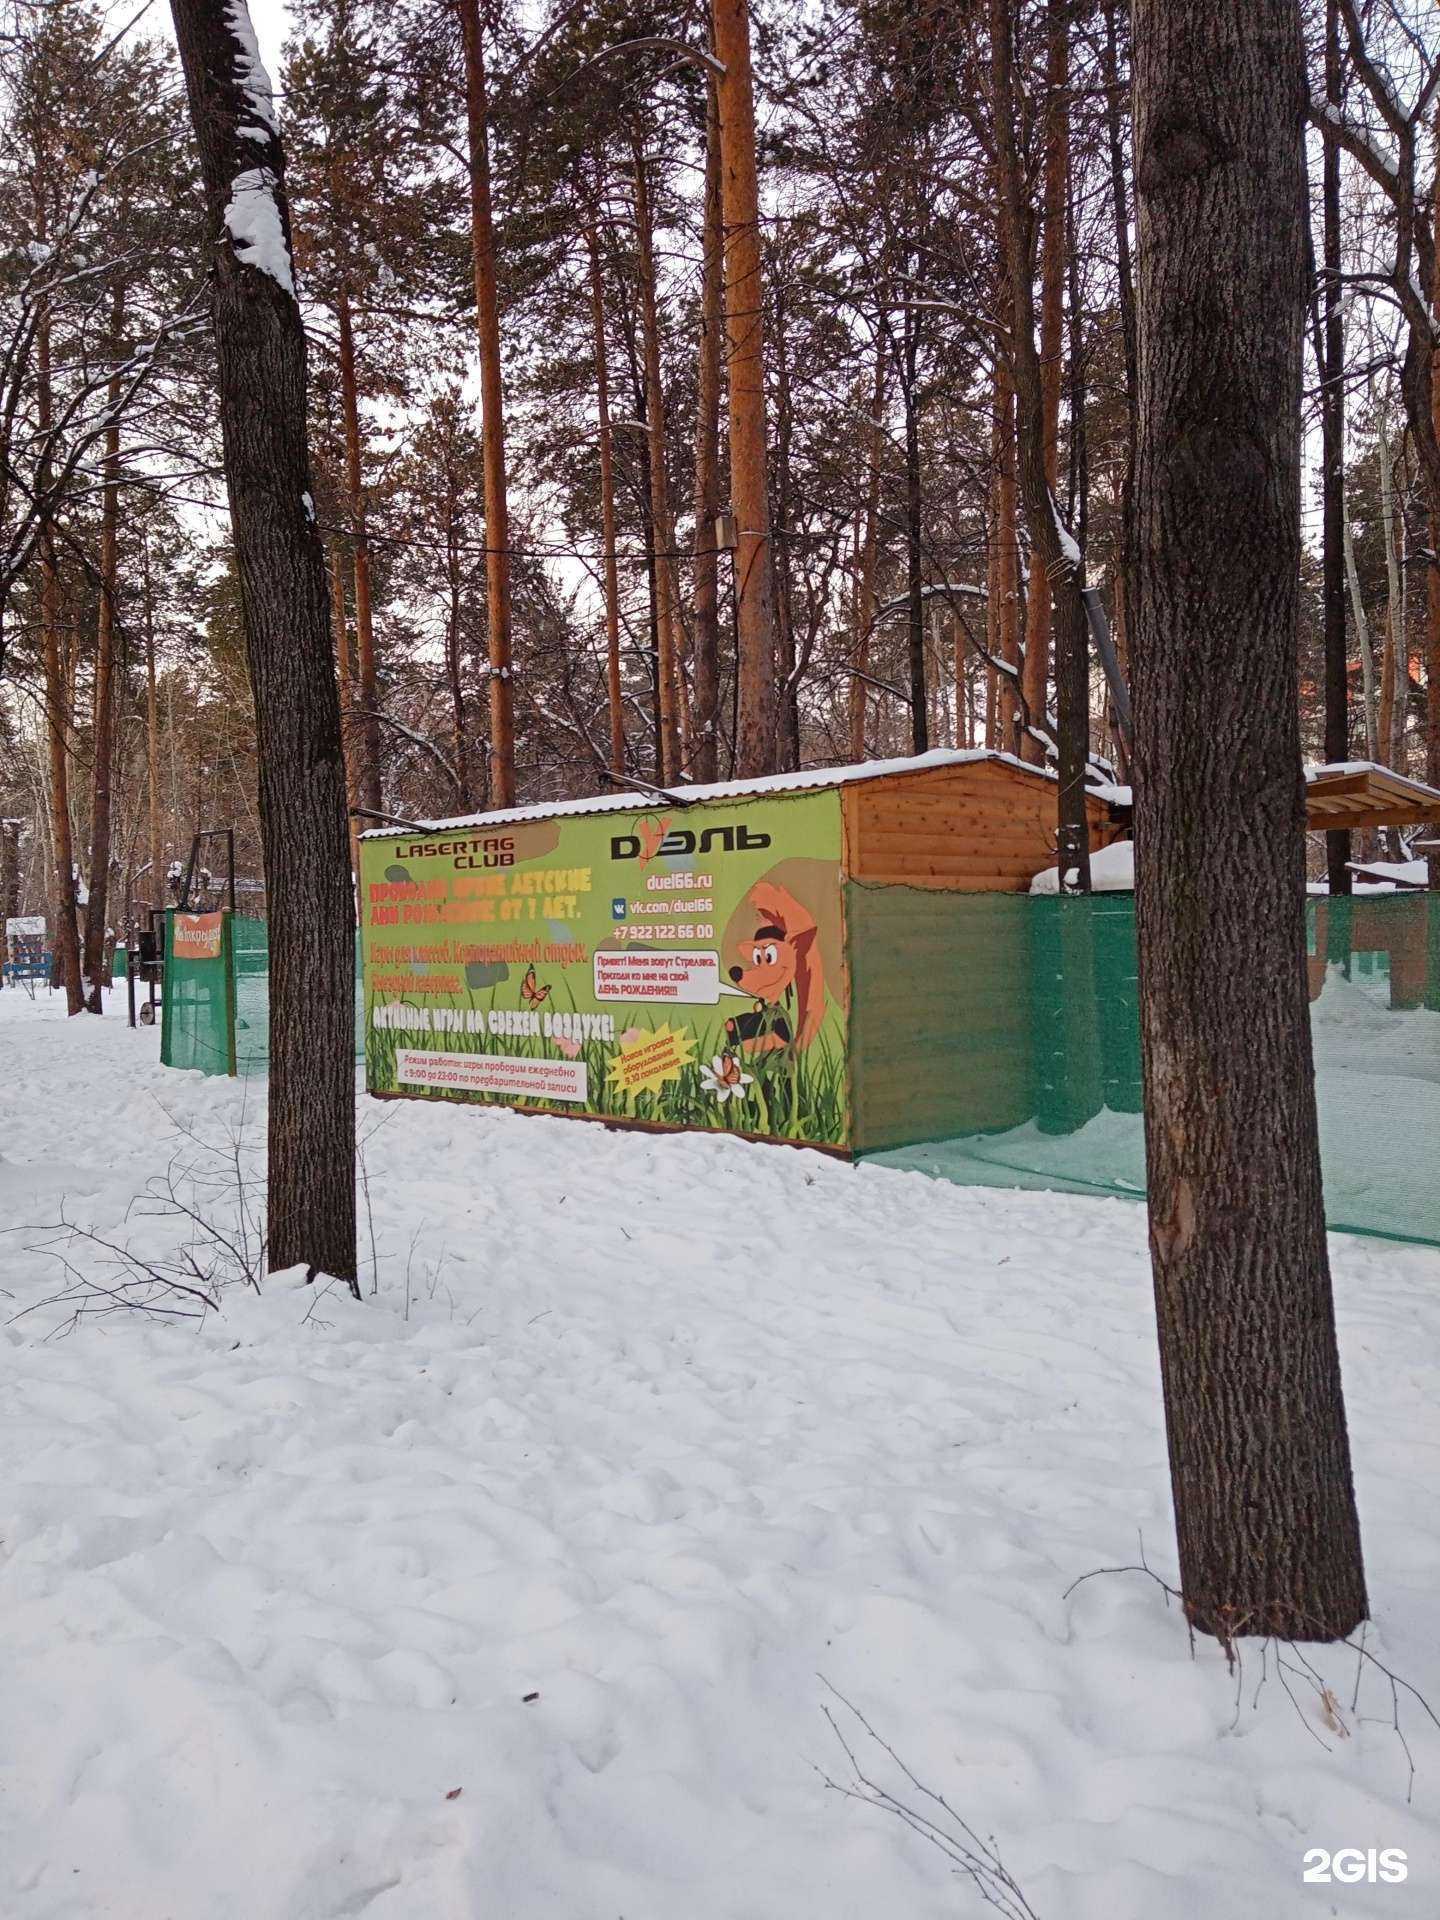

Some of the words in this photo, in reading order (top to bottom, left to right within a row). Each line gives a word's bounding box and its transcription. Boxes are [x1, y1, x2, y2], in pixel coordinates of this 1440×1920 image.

[396, 837, 514, 858] LASERTAG
[454, 853, 514, 869] CLUB
[647, 872, 713, 890] duel66.ru
[501, 898, 522, 920] ОТ
[543, 895, 581, 919] ЛЕТ.
[630, 899, 713, 915] vk.com/duel66
[613, 926, 628, 939] +7
[630, 925, 653, 939] 922
[655, 925, 676, 939] 122
[677, 925, 694, 939] 66
[696, 924, 713, 938] 00
[597, 956, 627, 968] Привет!
[628, 956, 649, 967] Меня
[651, 958, 674, 969] зовут
[597, 970, 630, 983] Приходи
[631, 972, 641, 981] ко
[642, 972, 658, 981] мне
[659, 973, 669, 982] на
[670, 971, 689, 982] свой
[598, 984, 620, 995] ДЕНЬ
[373, 1006, 431, 1031] АКТИВНЫЕ
[432, 1008, 464, 1033] ИГРЫ
[466, 1009, 486, 1034] НА
[488, 1010, 540, 1037] СВЕЖЕМ
[544, 1012, 615, 1044] ВОЗДУХЕ!
[620, 1049, 643, 1064] Новое
[623, 1047, 674, 1075] оборудование
[404, 1054, 428, 1065] Режим
[463, 1061, 483, 1072] игры
[484, 1062, 526, 1075] проводим
[528, 1065, 576, 1078] ежедневно
[427, 1071, 436, 1080] до
[438, 1071, 458, 1081] 23:00
[459, 1074, 469, 1083] по
[470, 1075, 546, 1090] предварительной
[547, 1083, 577, 1094] записи
